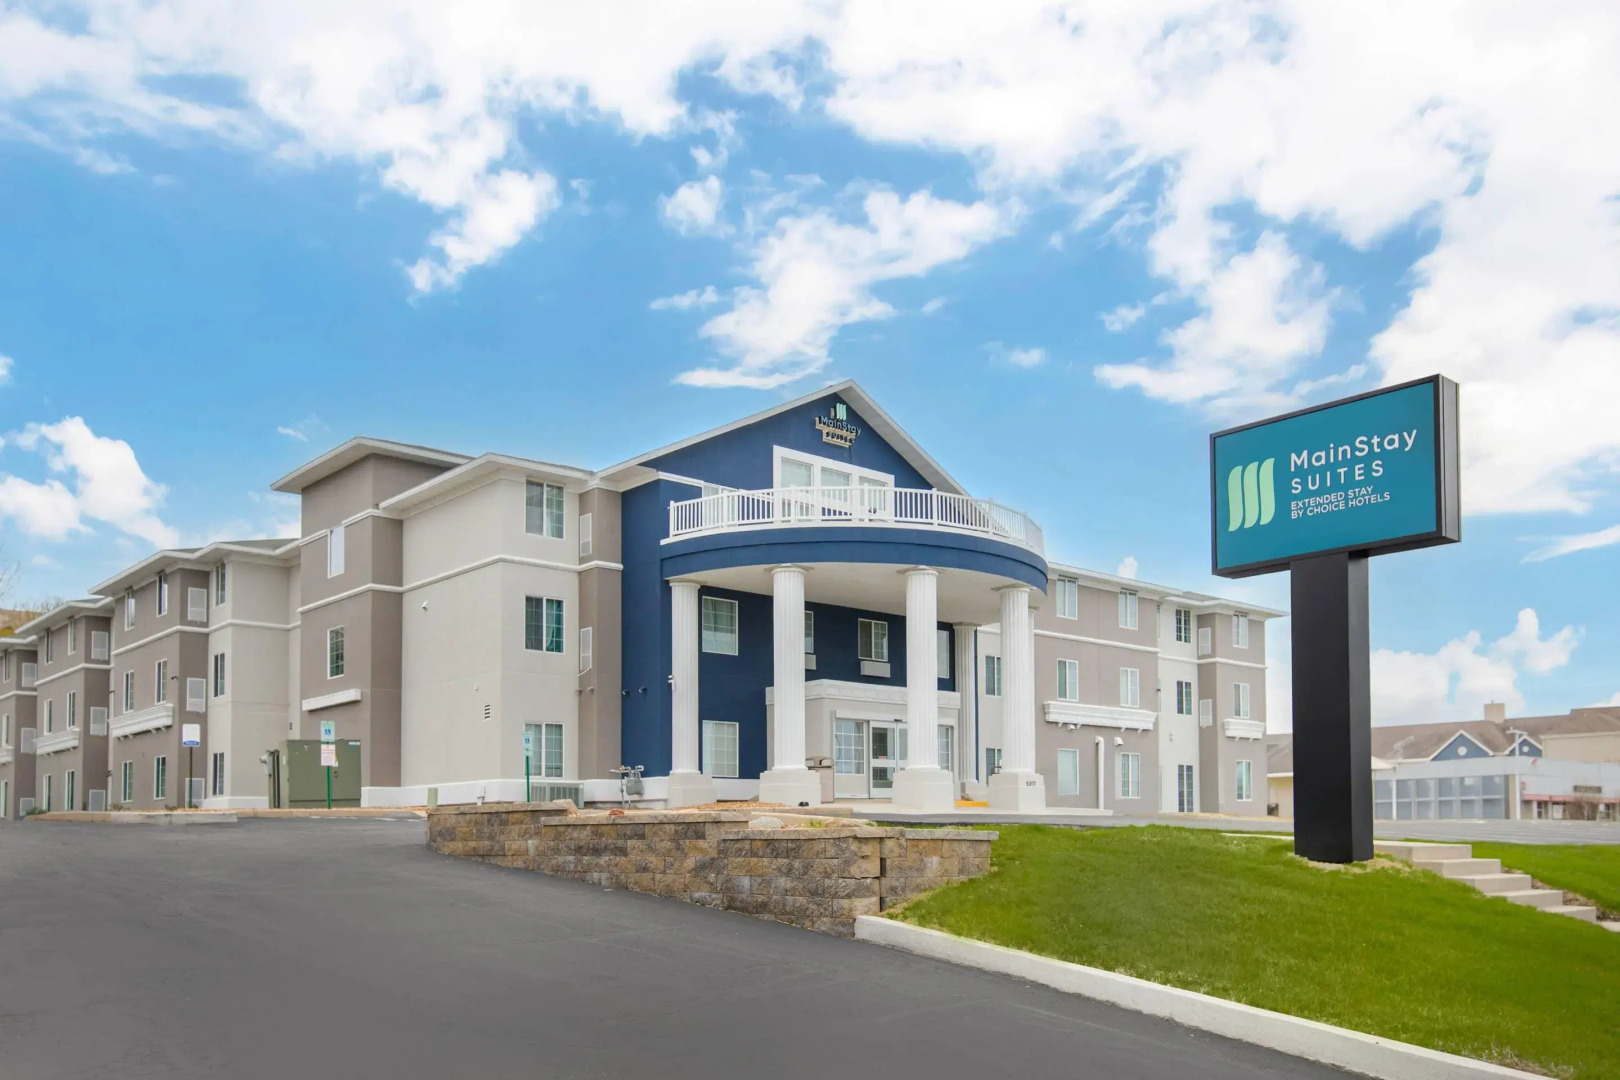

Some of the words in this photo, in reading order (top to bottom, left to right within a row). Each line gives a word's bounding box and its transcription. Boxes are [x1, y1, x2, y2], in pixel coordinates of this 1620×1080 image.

[821, 416, 861, 436] MainStay
[1290, 429, 1417, 472] MainStay
[1291, 460, 1384, 494] SUITES
[1291, 491, 1345, 510] EXTENDED
[1348, 485, 1374, 499] STAY
[1291, 509, 1304, 519] BY
[1307, 501, 1345, 516] CHOICE
[1348, 492, 1390, 508] HOTELS
